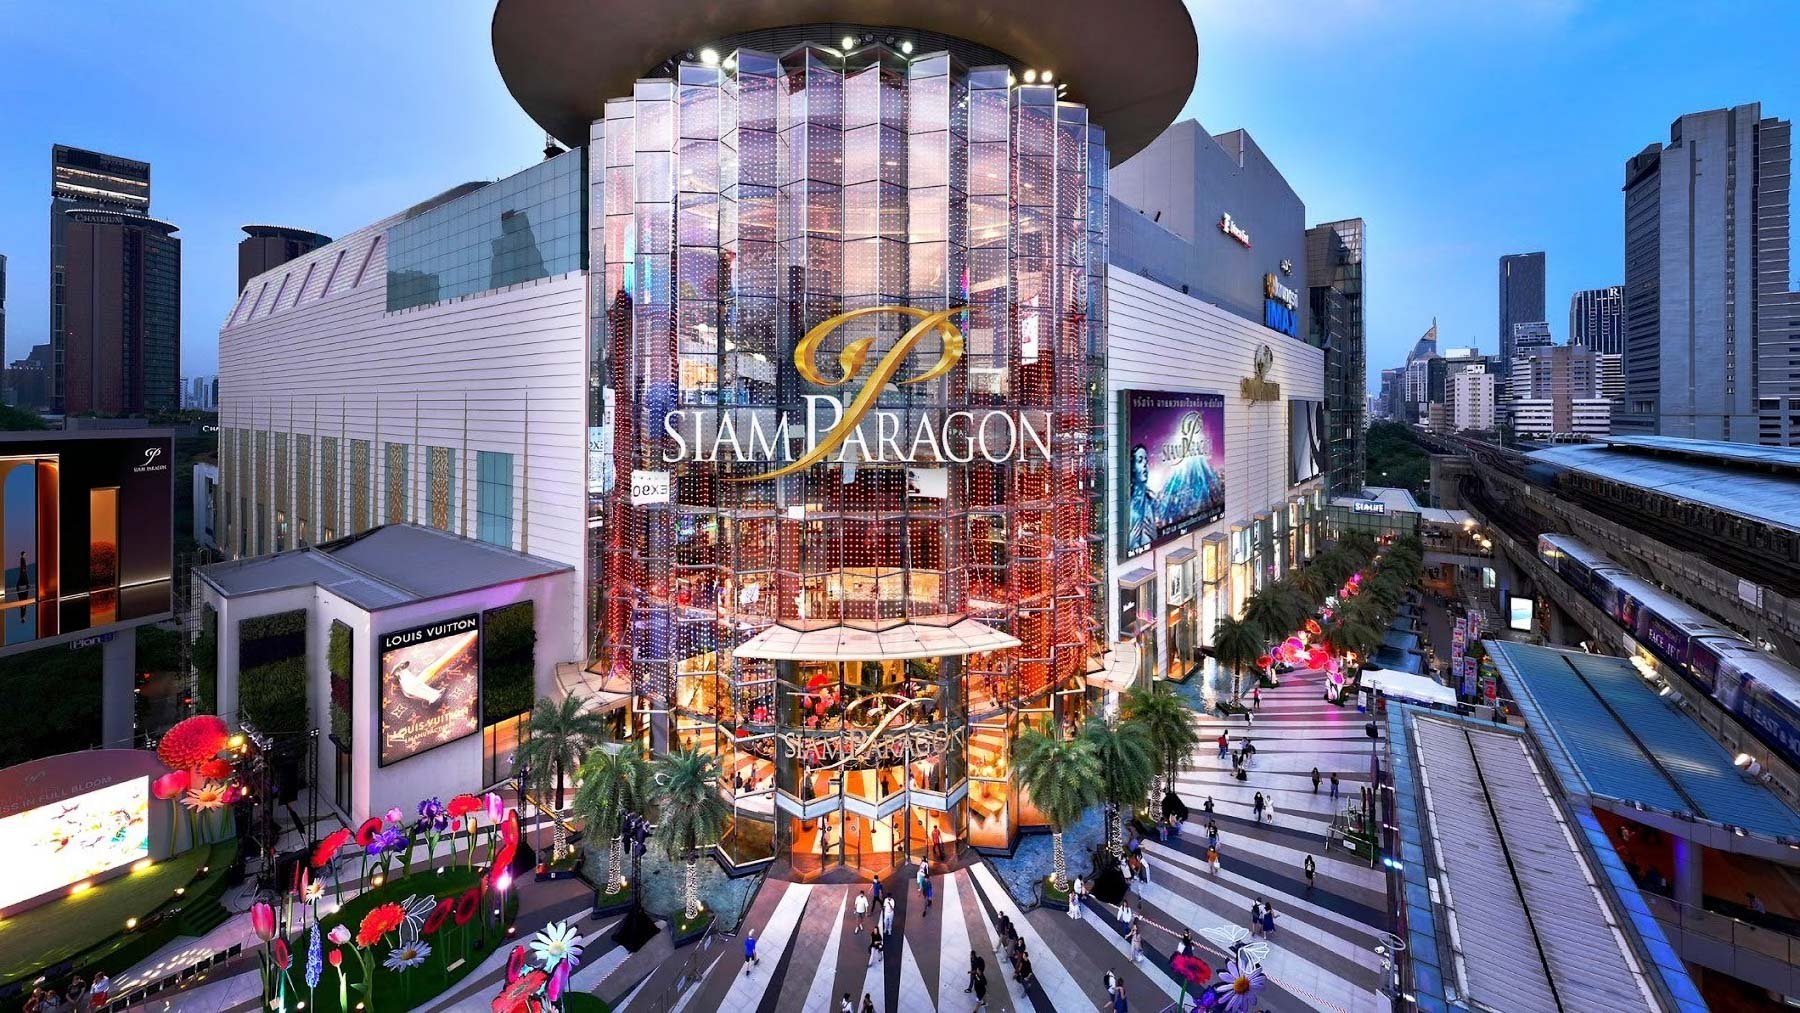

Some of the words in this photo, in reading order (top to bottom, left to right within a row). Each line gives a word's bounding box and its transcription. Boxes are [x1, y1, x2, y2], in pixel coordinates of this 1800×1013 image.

[1266, 298, 1297, 336] IMAX
[663, 410, 794, 464] SIAM
[801, 394, 1053, 464] PARAGON
[386, 630, 422, 647] LOUIS
[427, 618, 476, 637] VUITTON
[784, 731, 846, 761] SIAM
[847, 726, 966, 760] PARAGON
